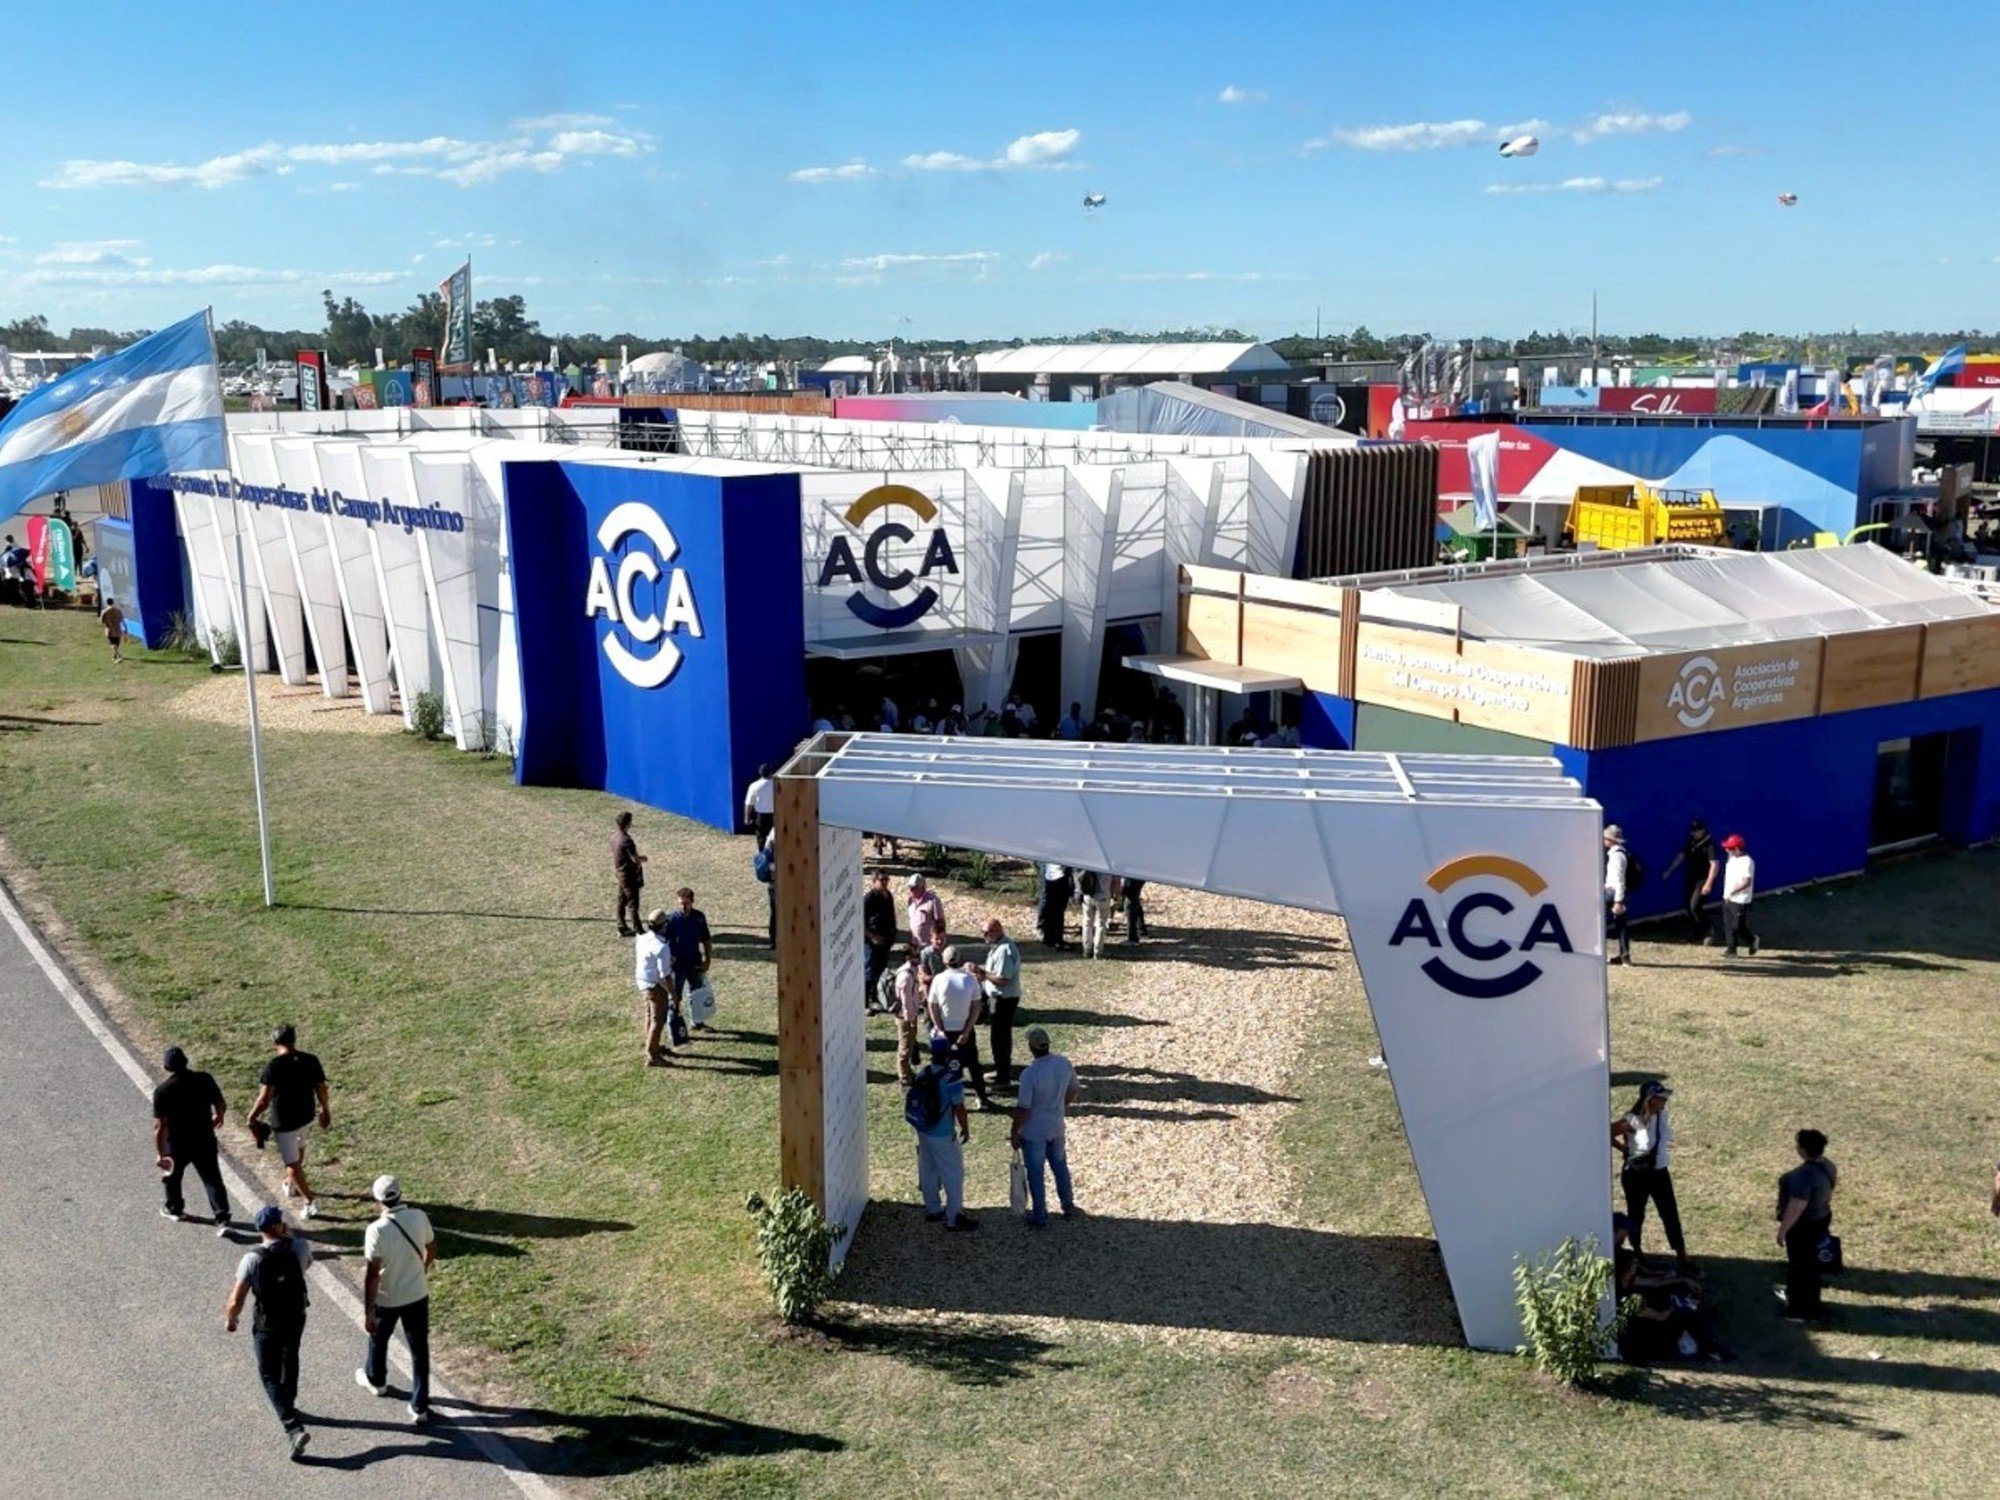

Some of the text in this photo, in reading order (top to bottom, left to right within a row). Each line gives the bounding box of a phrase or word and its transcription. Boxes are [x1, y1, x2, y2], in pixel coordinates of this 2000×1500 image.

[232, 477, 308, 512] Cooperativas
[311, 486, 332, 514] del
[332, 490, 382, 528] Campo
[382, 497, 464, 535] Argentino
[819, 522, 959, 591] ACA
[585, 550, 703, 643] ACA
[1667, 675, 1725, 709] ACA
[1732, 675, 1796, 695] Cooperativas
[1733, 657, 1799, 678] Asociación de
[1388, 891, 1575, 962] ACA
